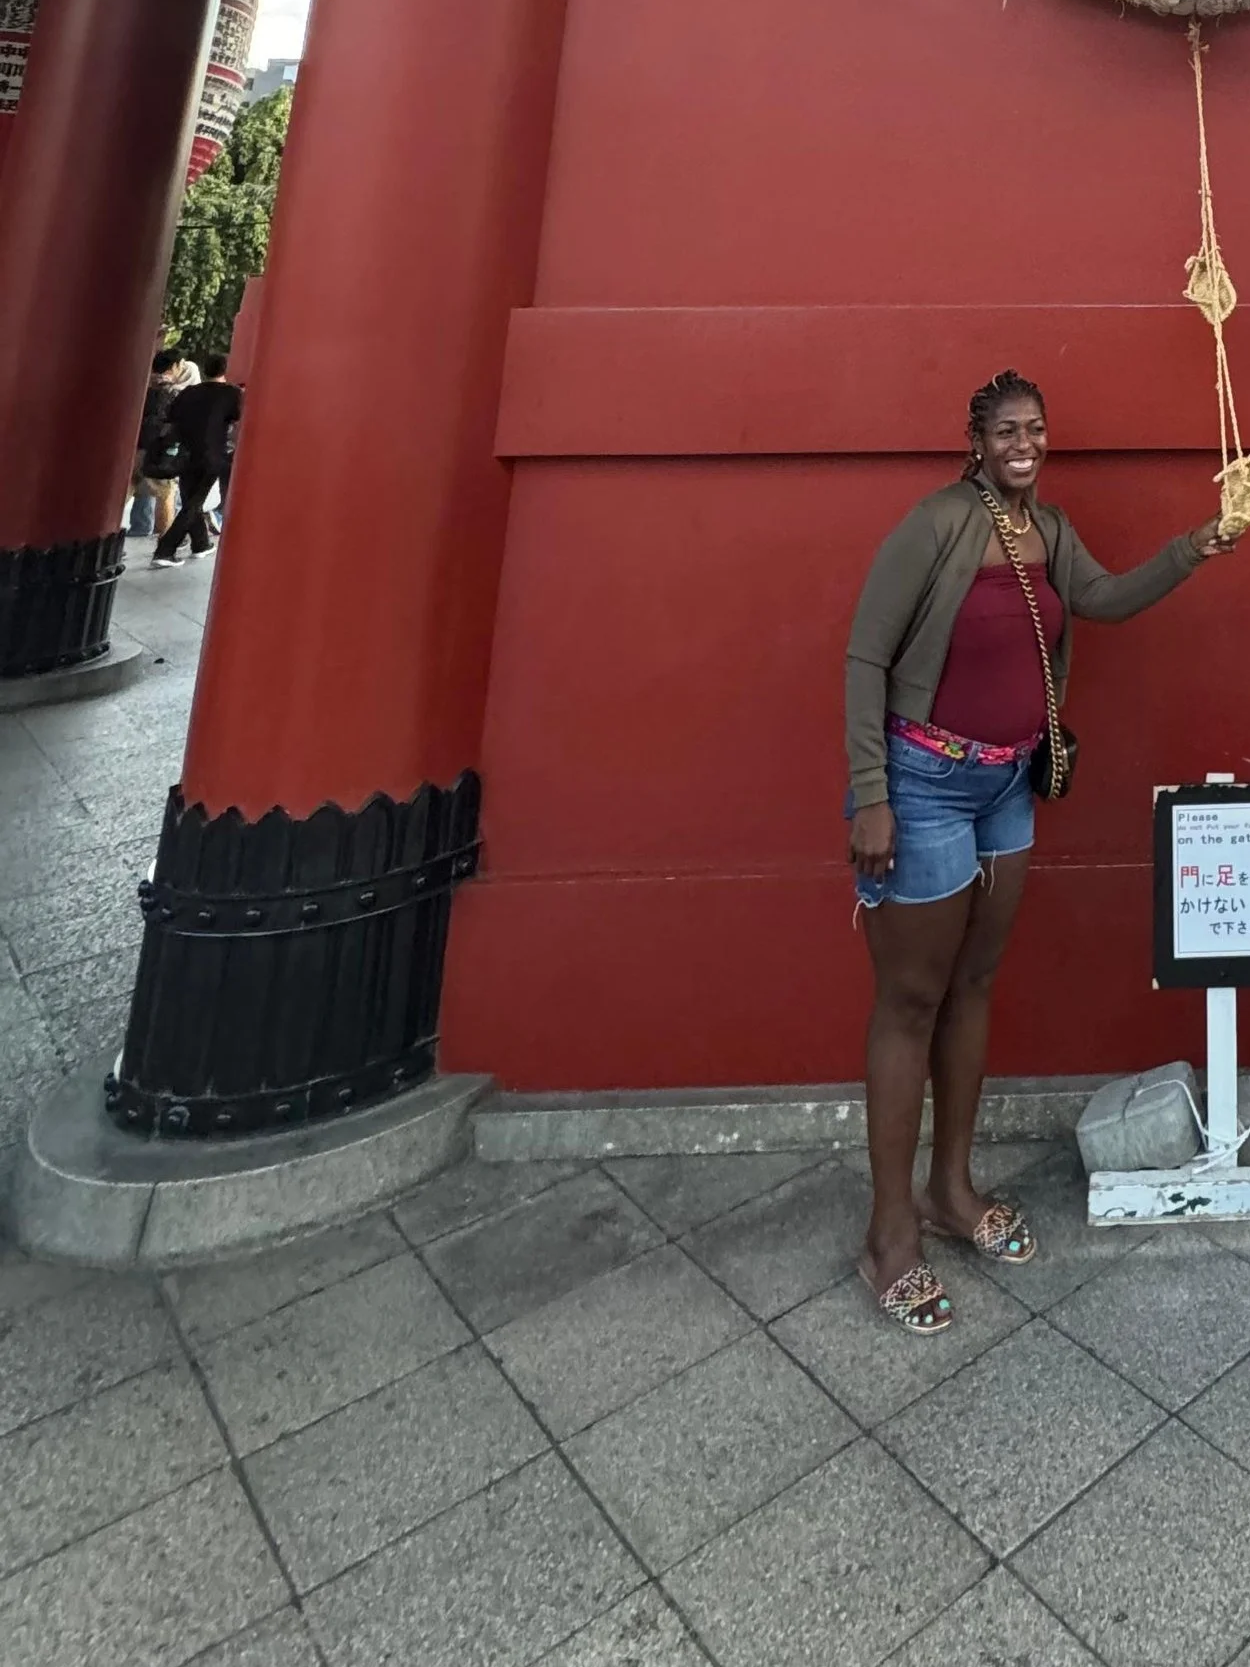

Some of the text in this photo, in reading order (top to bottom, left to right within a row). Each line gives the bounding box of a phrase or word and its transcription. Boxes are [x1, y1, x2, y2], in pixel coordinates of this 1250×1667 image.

[1178, 813, 1218, 822] Please
[1177, 836, 1193, 845] on
[1201, 834, 1223, 844] the
[1180, 864, 1250, 889] 門に足を
[1180, 896, 1246, 914] かけない
